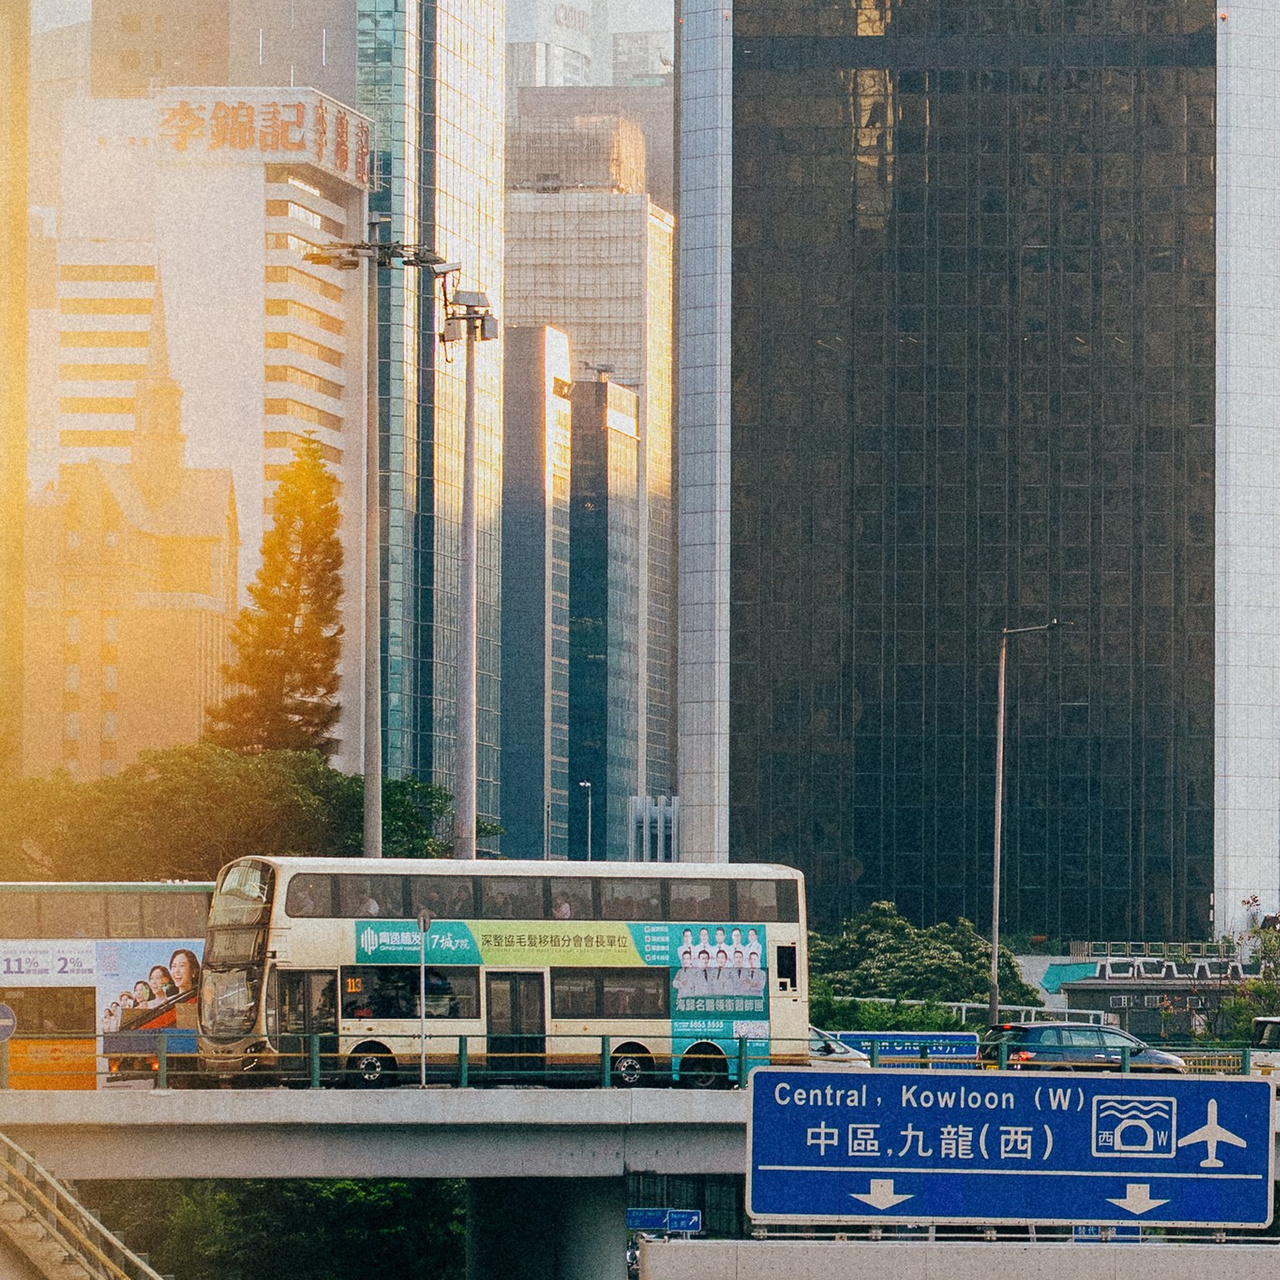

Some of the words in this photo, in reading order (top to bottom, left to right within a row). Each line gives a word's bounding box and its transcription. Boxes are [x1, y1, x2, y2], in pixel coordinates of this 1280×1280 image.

[159, 100, 306, 153] 李錦記
[3, 957, 39, 974] 11%
[57, 957, 83, 974] 2%
[346, 978, 362, 993] 113
[901, 1084, 1015, 1111] Kowloon
[1034, 1086, 1086, 1112] (W)
[1098, 1131, 1114, 1147] 西
[1157, 1131, 1168, 1147] W
